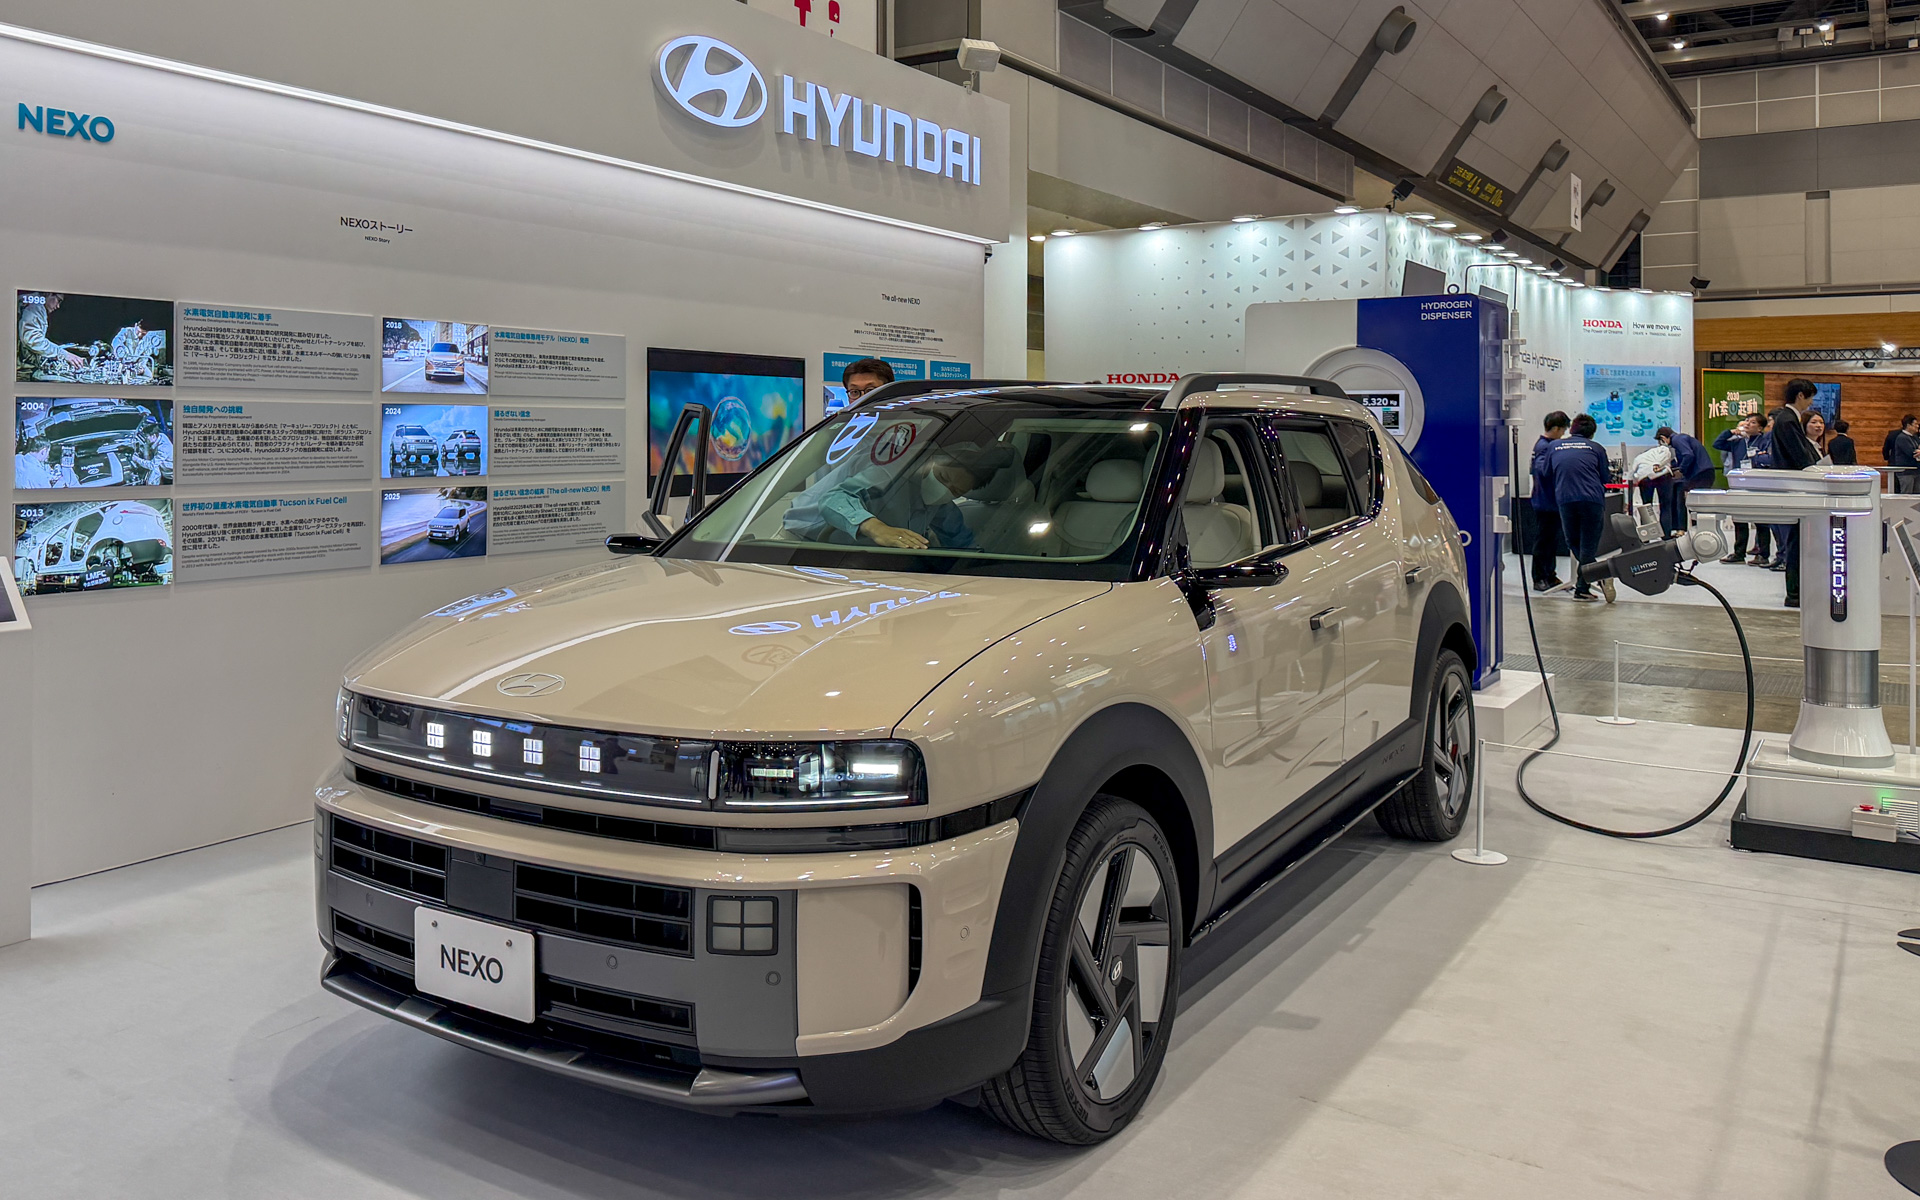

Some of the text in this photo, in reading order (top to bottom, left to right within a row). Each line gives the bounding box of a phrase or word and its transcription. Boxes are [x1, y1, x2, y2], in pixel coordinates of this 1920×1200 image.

[18, 103, 115, 142] NEXO
[784, 74, 980, 185] HYUNDAI
[340, 216, 413, 234] NEXOストーリー
[22, 295, 46, 305] 1998
[881, 293, 921, 305] The all-new NEXO
[1420, 301, 1472, 310] HYDROGEN
[1420, 311, 1473, 321] DISPENSER
[386, 321, 402, 329] 2018
[1583, 319, 1623, 328] HONDA
[1106, 373, 1180, 384] HONDA
[1726, 391, 1740, 401] 2030
[21, 402, 45, 411] 2004
[279, 499, 306, 507] Tucson
[333, 496, 347, 504] Cell
[384, 493, 401, 501] 2025
[20, 508, 44, 518] 2013
[1832, 527, 1845, 603] READY
[440, 943, 504, 984] NEXO
[1065, 1077, 1089, 1123] NEXEN
